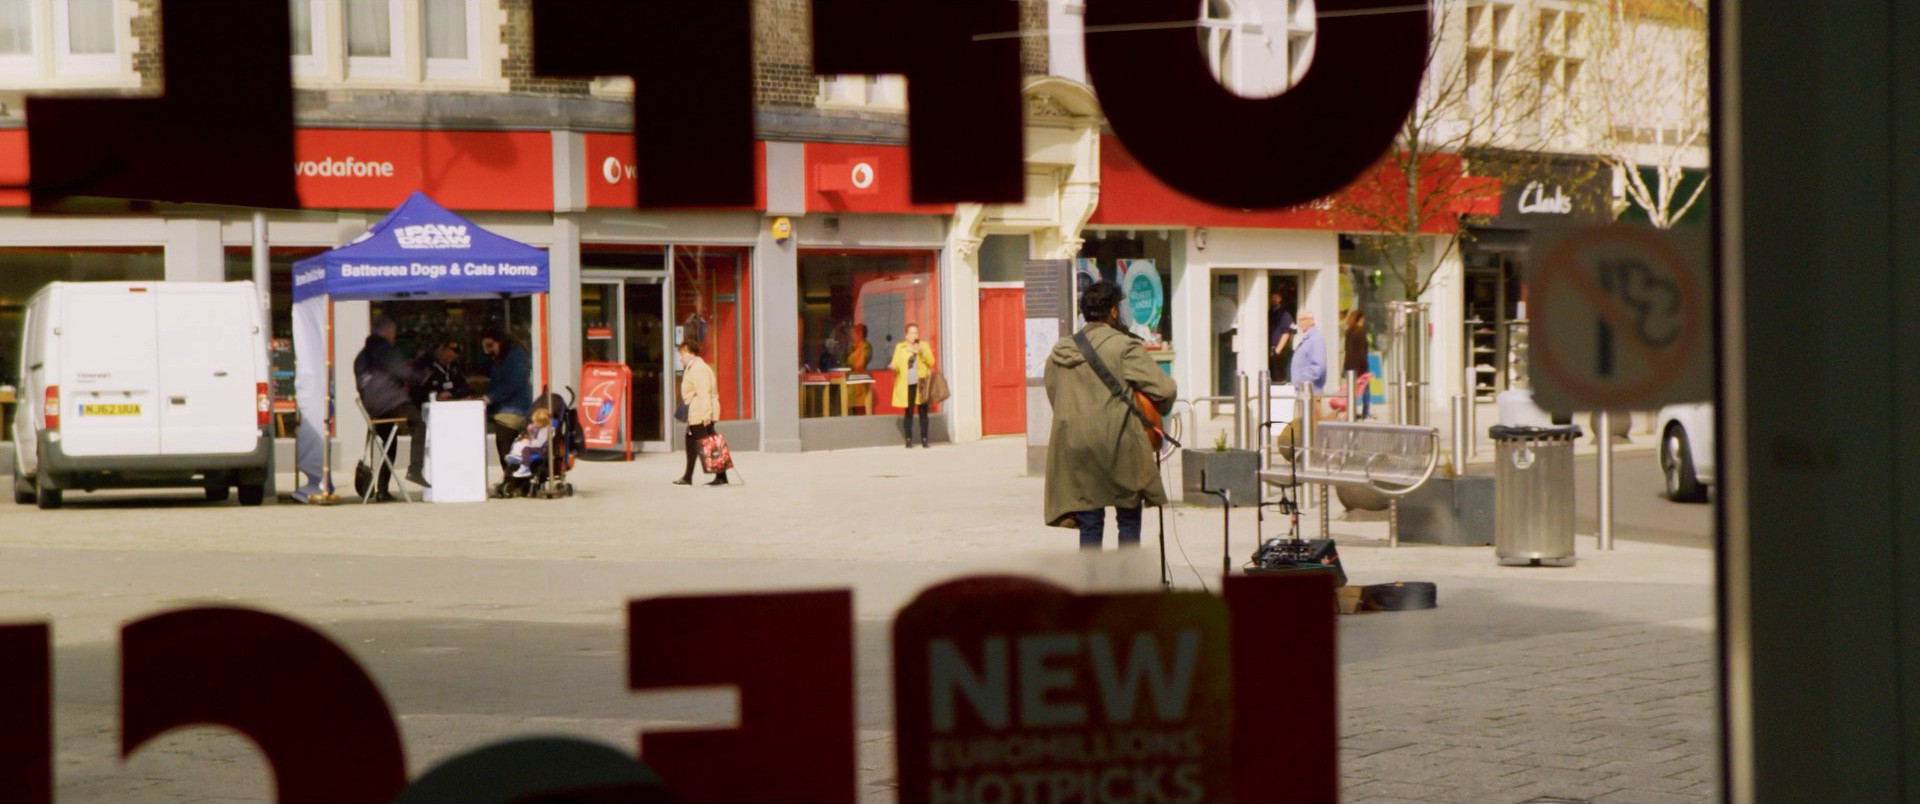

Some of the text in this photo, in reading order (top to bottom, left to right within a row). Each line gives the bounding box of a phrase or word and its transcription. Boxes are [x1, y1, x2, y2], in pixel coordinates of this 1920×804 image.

[294, 156, 394, 177] vodafone
[1518, 180, 1572, 214] Clarks
[397, 235, 472, 246] DRAW
[404, 223, 467, 237] PAW
[341, 263, 408, 278] Battersea
[410, 263, 447, 278] Dogs
[450, 263, 461, 276] &
[464, 262, 495, 276] Cats
[498, 262, 538, 276] Home
[927, 629, 1203, 733] NEW
[928, 729, 1204, 768] EUROMILLIONS
[929, 765, 1206, 804] HOTPICKS
